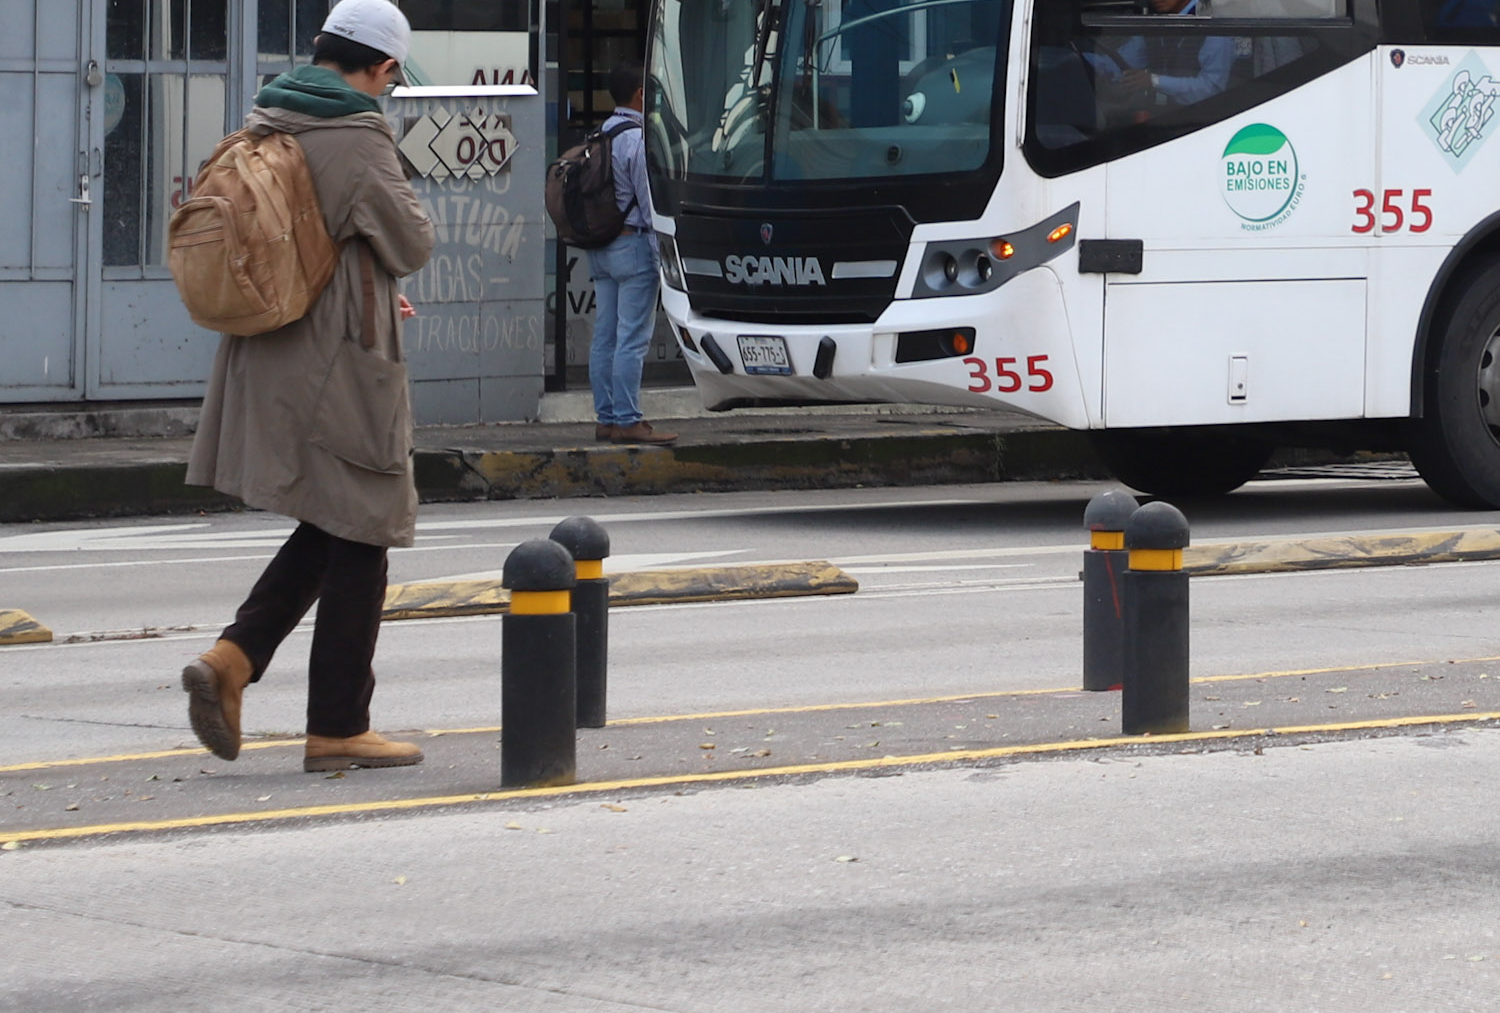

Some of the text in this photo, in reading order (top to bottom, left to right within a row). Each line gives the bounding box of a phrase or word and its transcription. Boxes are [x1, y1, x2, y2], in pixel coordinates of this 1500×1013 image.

[1407, 55, 1450, 65] SCANIA
[1227, 160, 1287, 179] BAJO EN
[1227, 177, 1290, 191] EMISIONES
[1351, 188, 1433, 234] 355
[725, 254, 826, 285] SCANIA
[962, 354, 1054, 393] 355
